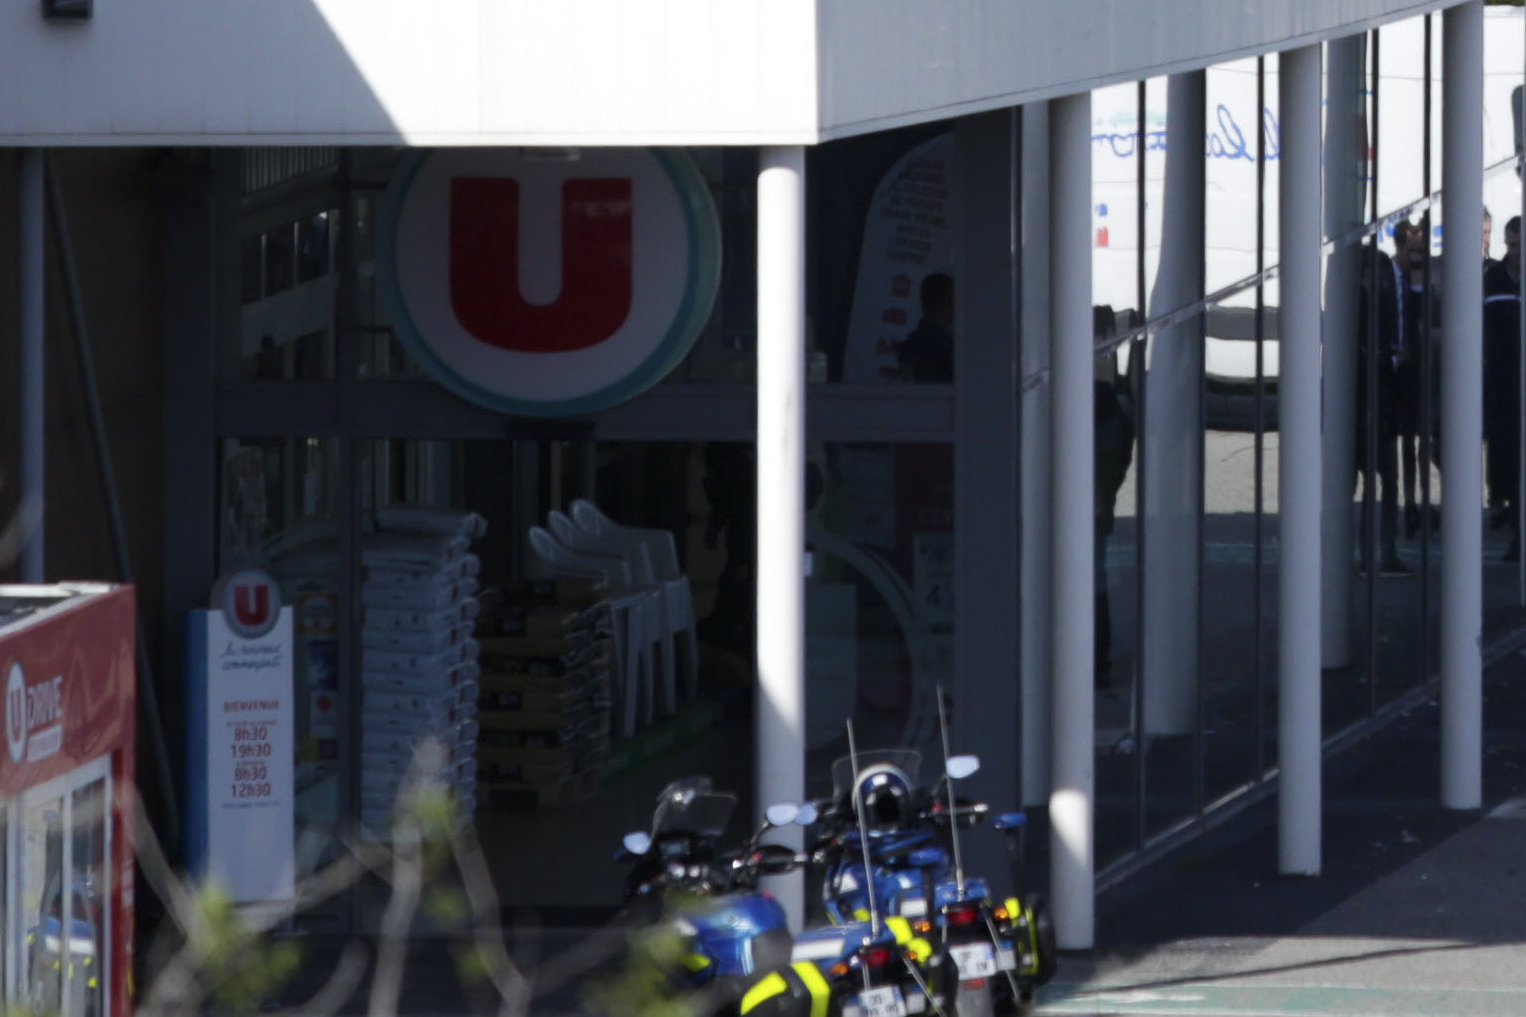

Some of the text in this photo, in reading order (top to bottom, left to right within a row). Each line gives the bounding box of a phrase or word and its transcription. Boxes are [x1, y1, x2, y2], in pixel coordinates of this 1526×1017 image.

[450, 177, 633, 353] U
[235, 585, 269, 625] U
[28, 675, 64, 729] DRIVE
